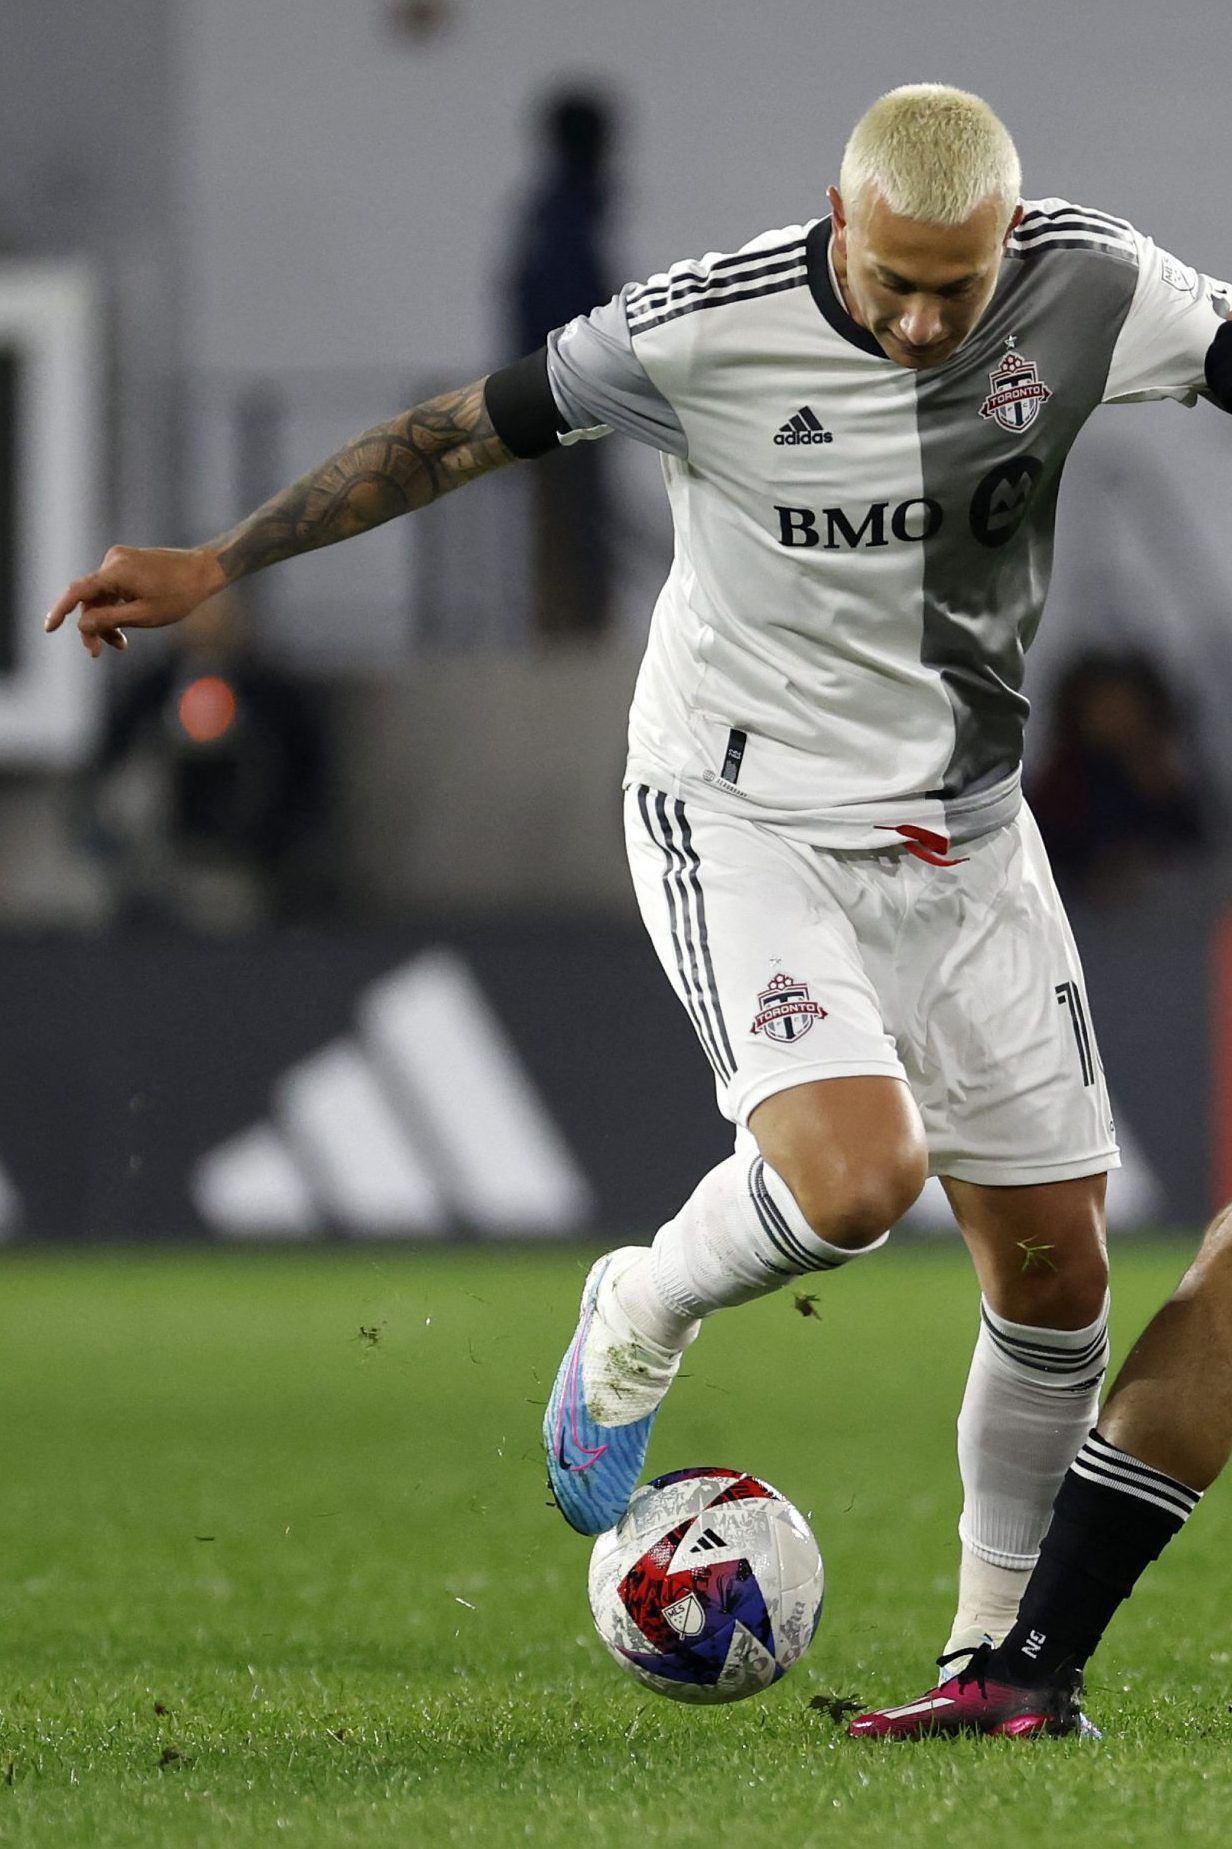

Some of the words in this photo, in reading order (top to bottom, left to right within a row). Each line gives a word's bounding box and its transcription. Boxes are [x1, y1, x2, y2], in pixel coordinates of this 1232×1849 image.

[989, 385, 1040, 407] TORONTO
[773, 430, 834, 445] adidas
[773, 498, 943, 549] BMO
[756, 1002, 816, 1024] TORONTO
